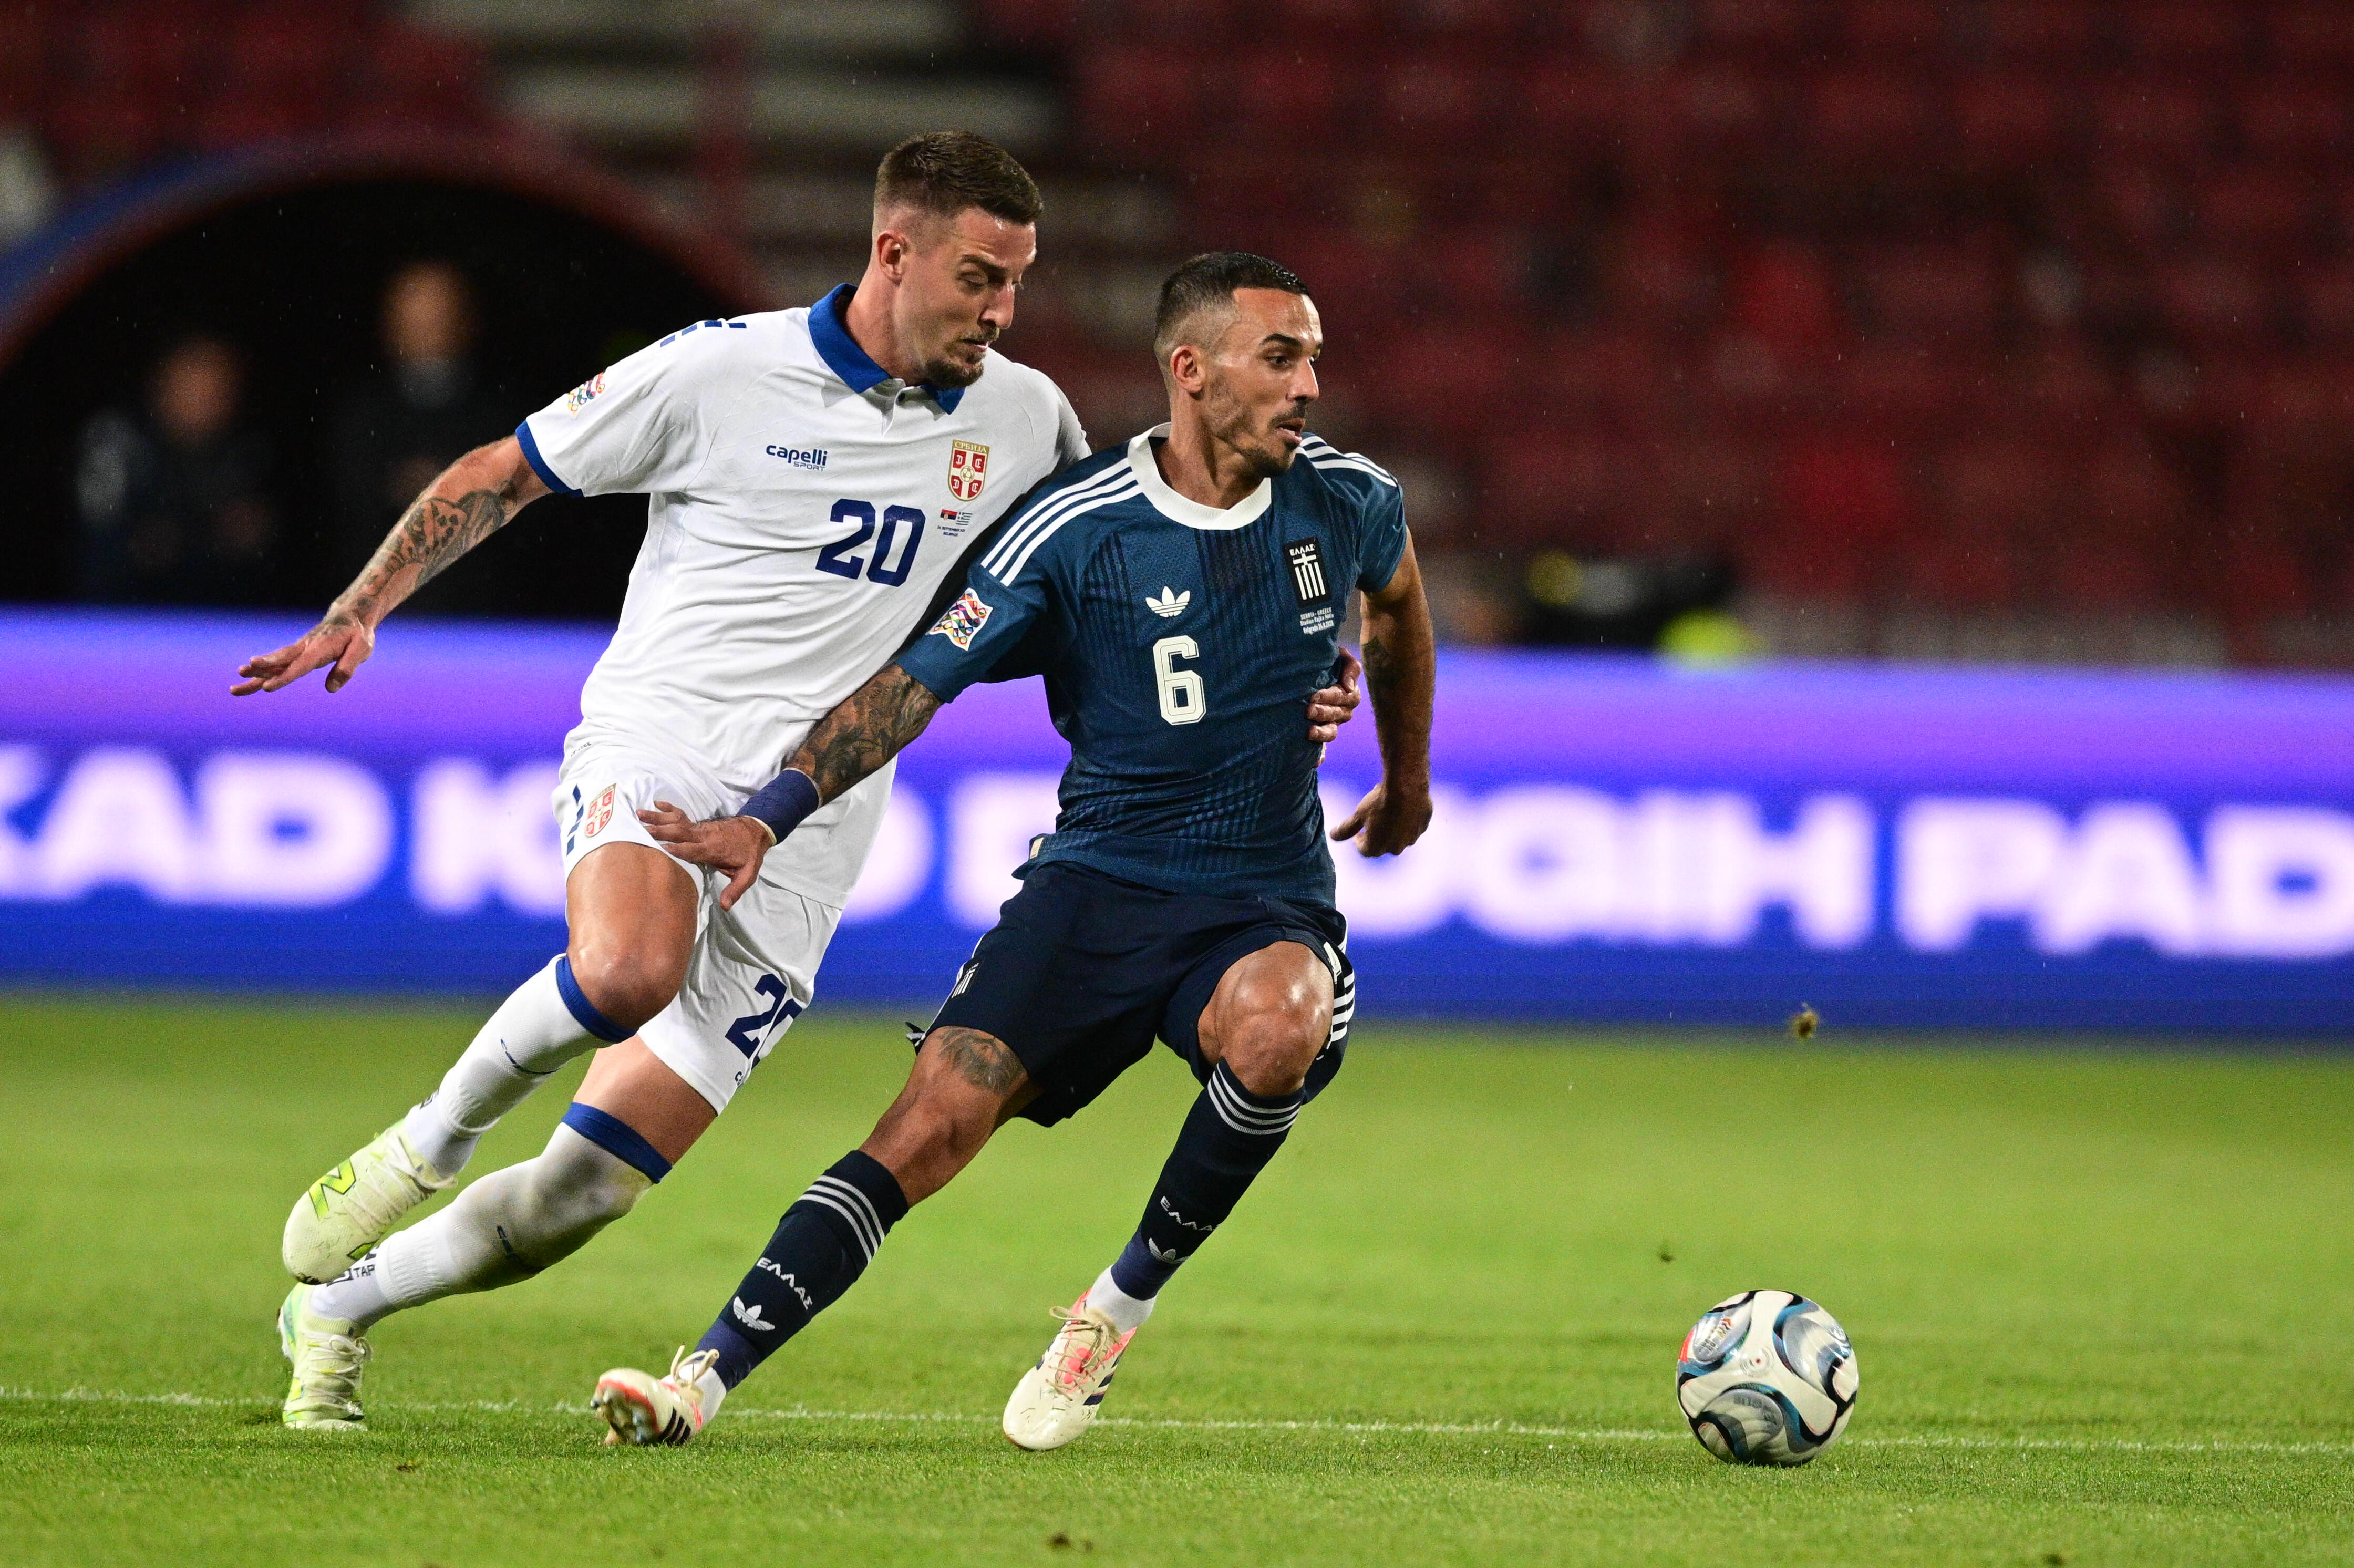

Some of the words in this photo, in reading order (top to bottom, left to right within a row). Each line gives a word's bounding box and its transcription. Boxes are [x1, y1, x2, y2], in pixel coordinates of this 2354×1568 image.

[766, 445, 828, 466] capelli
[955, 442, 986, 453] СРБИЈА
[793, 461, 825, 472] SPORT
[815, 499, 926, 587] 20
[1289, 544, 1315, 556] ΕΛΛΑΣ
[1317, 607, 1332, 615] GREECE
[1153, 635, 1206, 725] 6
[1896, 796, 2354, 954] PAD
[757, 1257, 813, 1310] ΕΛΛΑΣ
